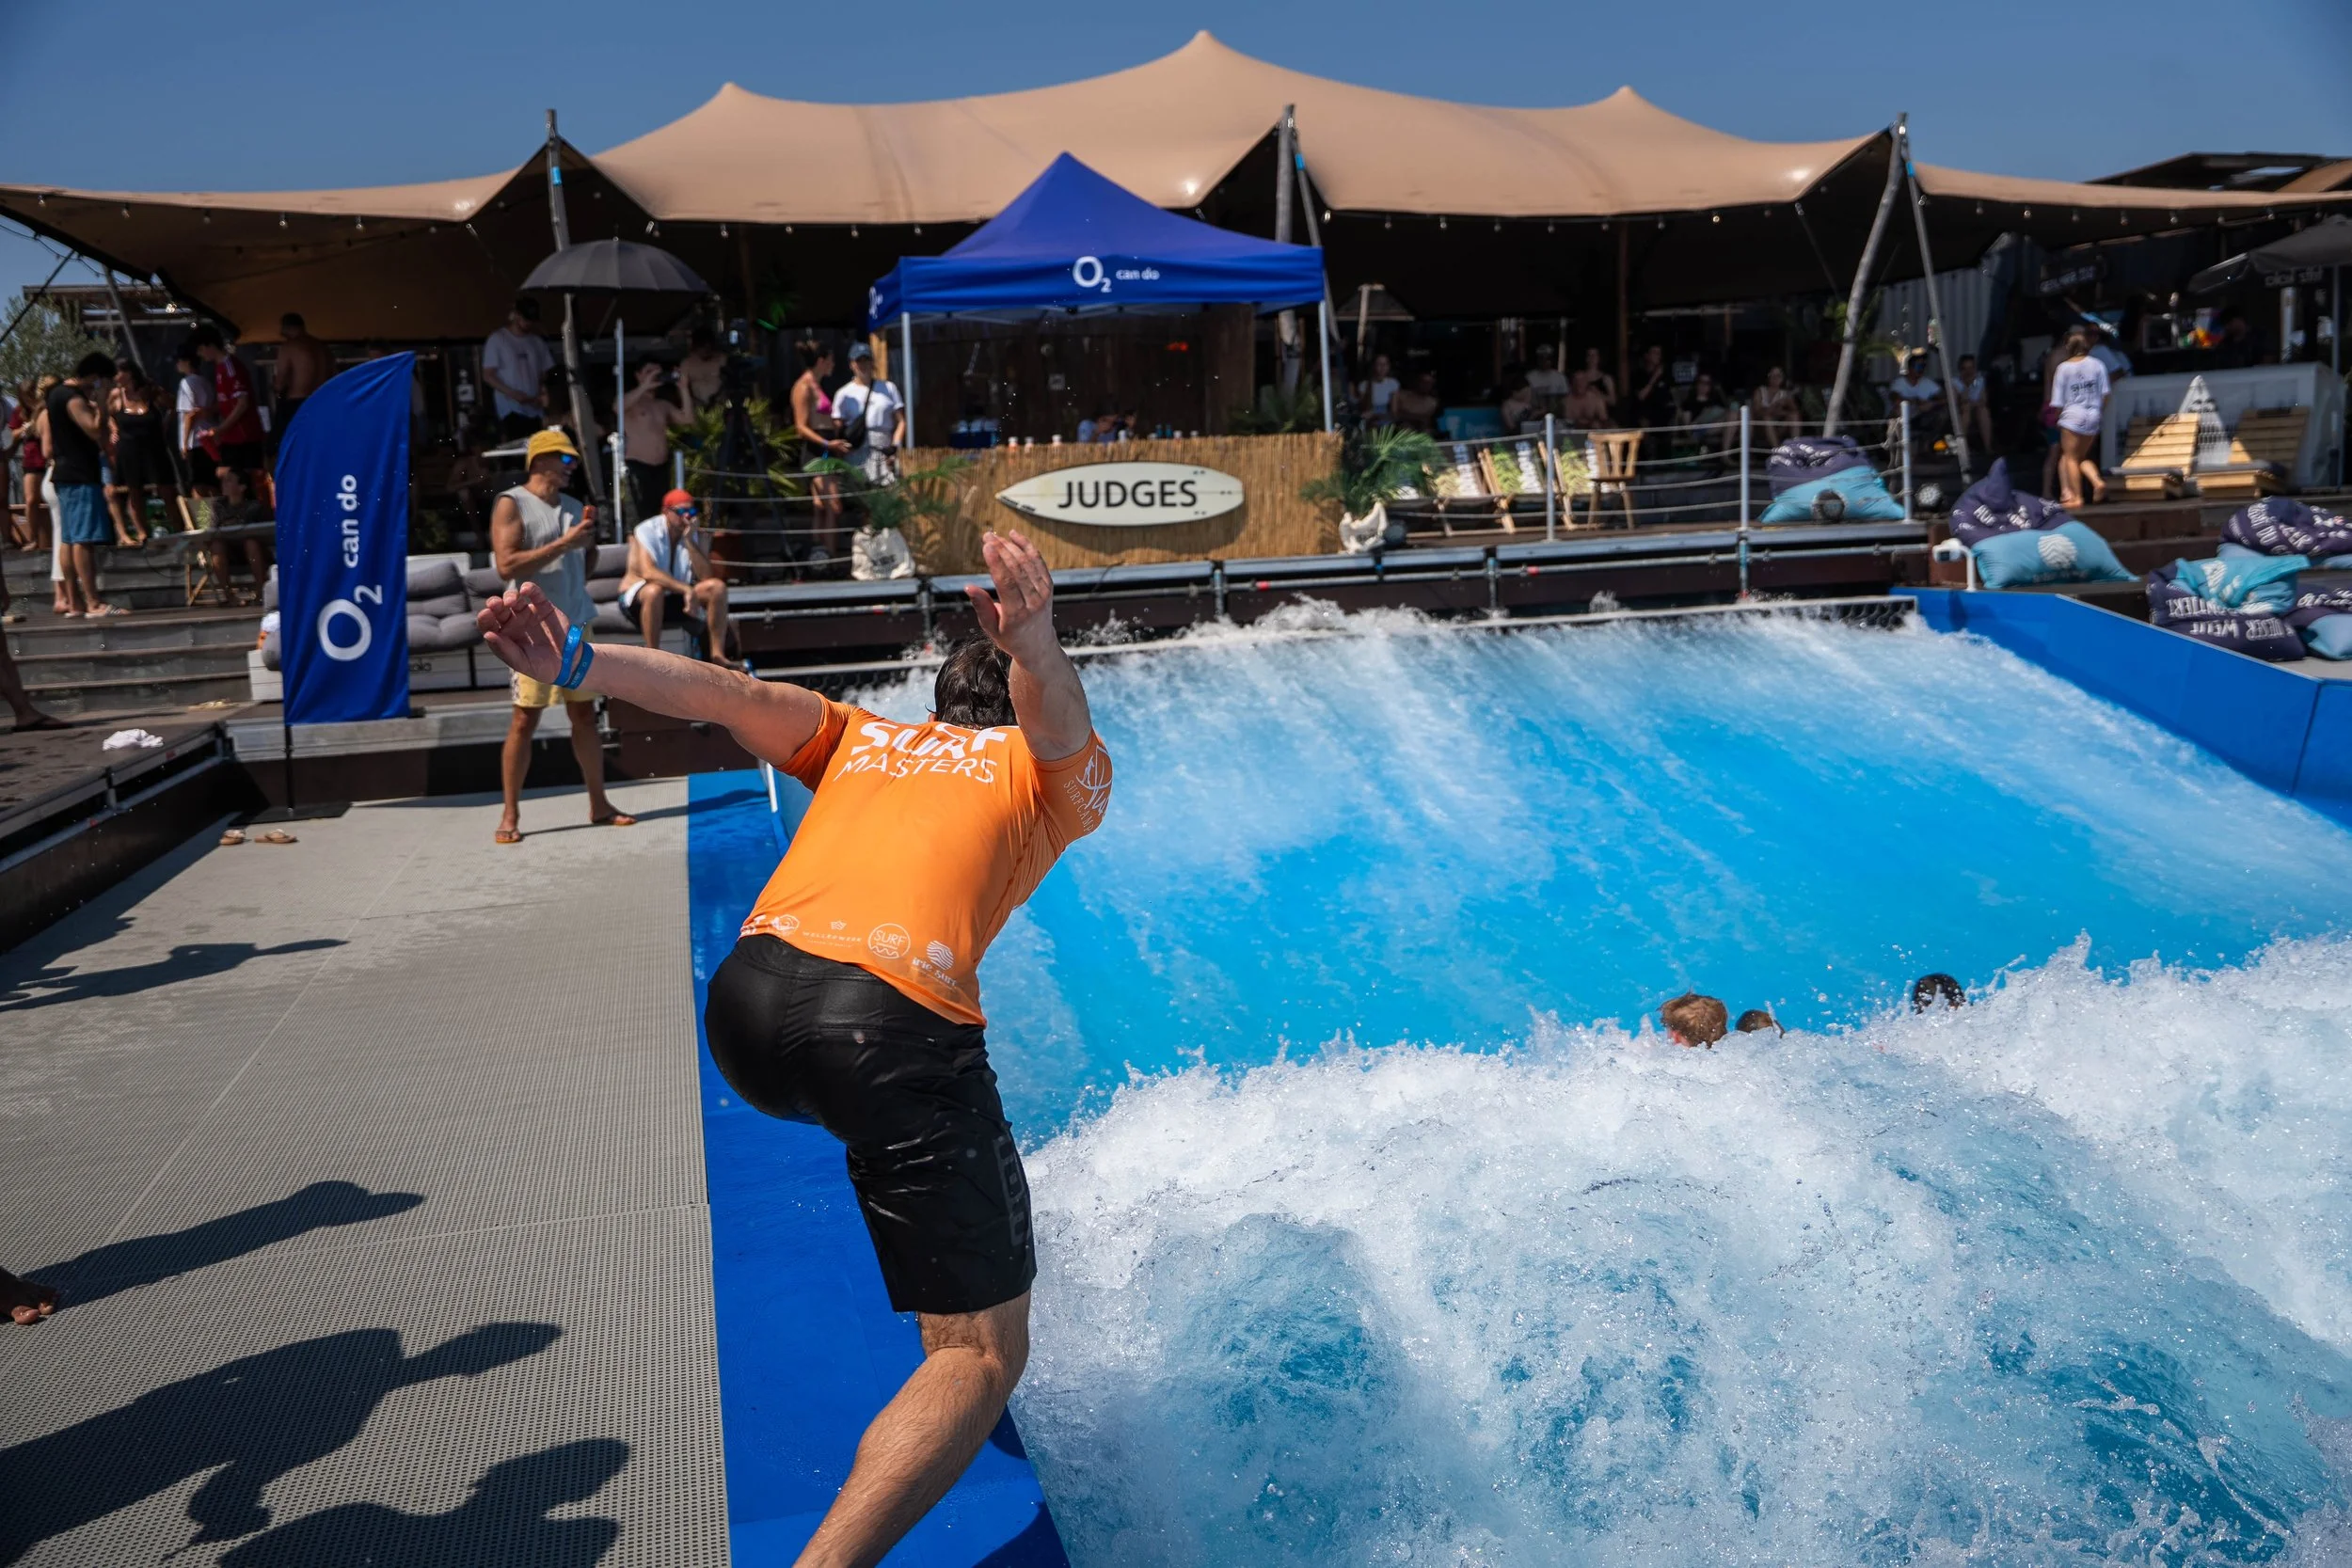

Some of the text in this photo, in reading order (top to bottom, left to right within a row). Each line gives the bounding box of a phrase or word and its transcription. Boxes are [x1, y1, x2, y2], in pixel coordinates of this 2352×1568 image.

[1116, 269, 1140, 280] can
[1141, 266, 1160, 280] do
[336, 474, 358, 512] do
[1057, 480, 1198, 509] JUDGES
[341, 518, 359, 568] can
[850, 721, 1009, 759] SURF
[833, 752, 998, 784] MASTERS
[873, 929, 908, 947] SURF
